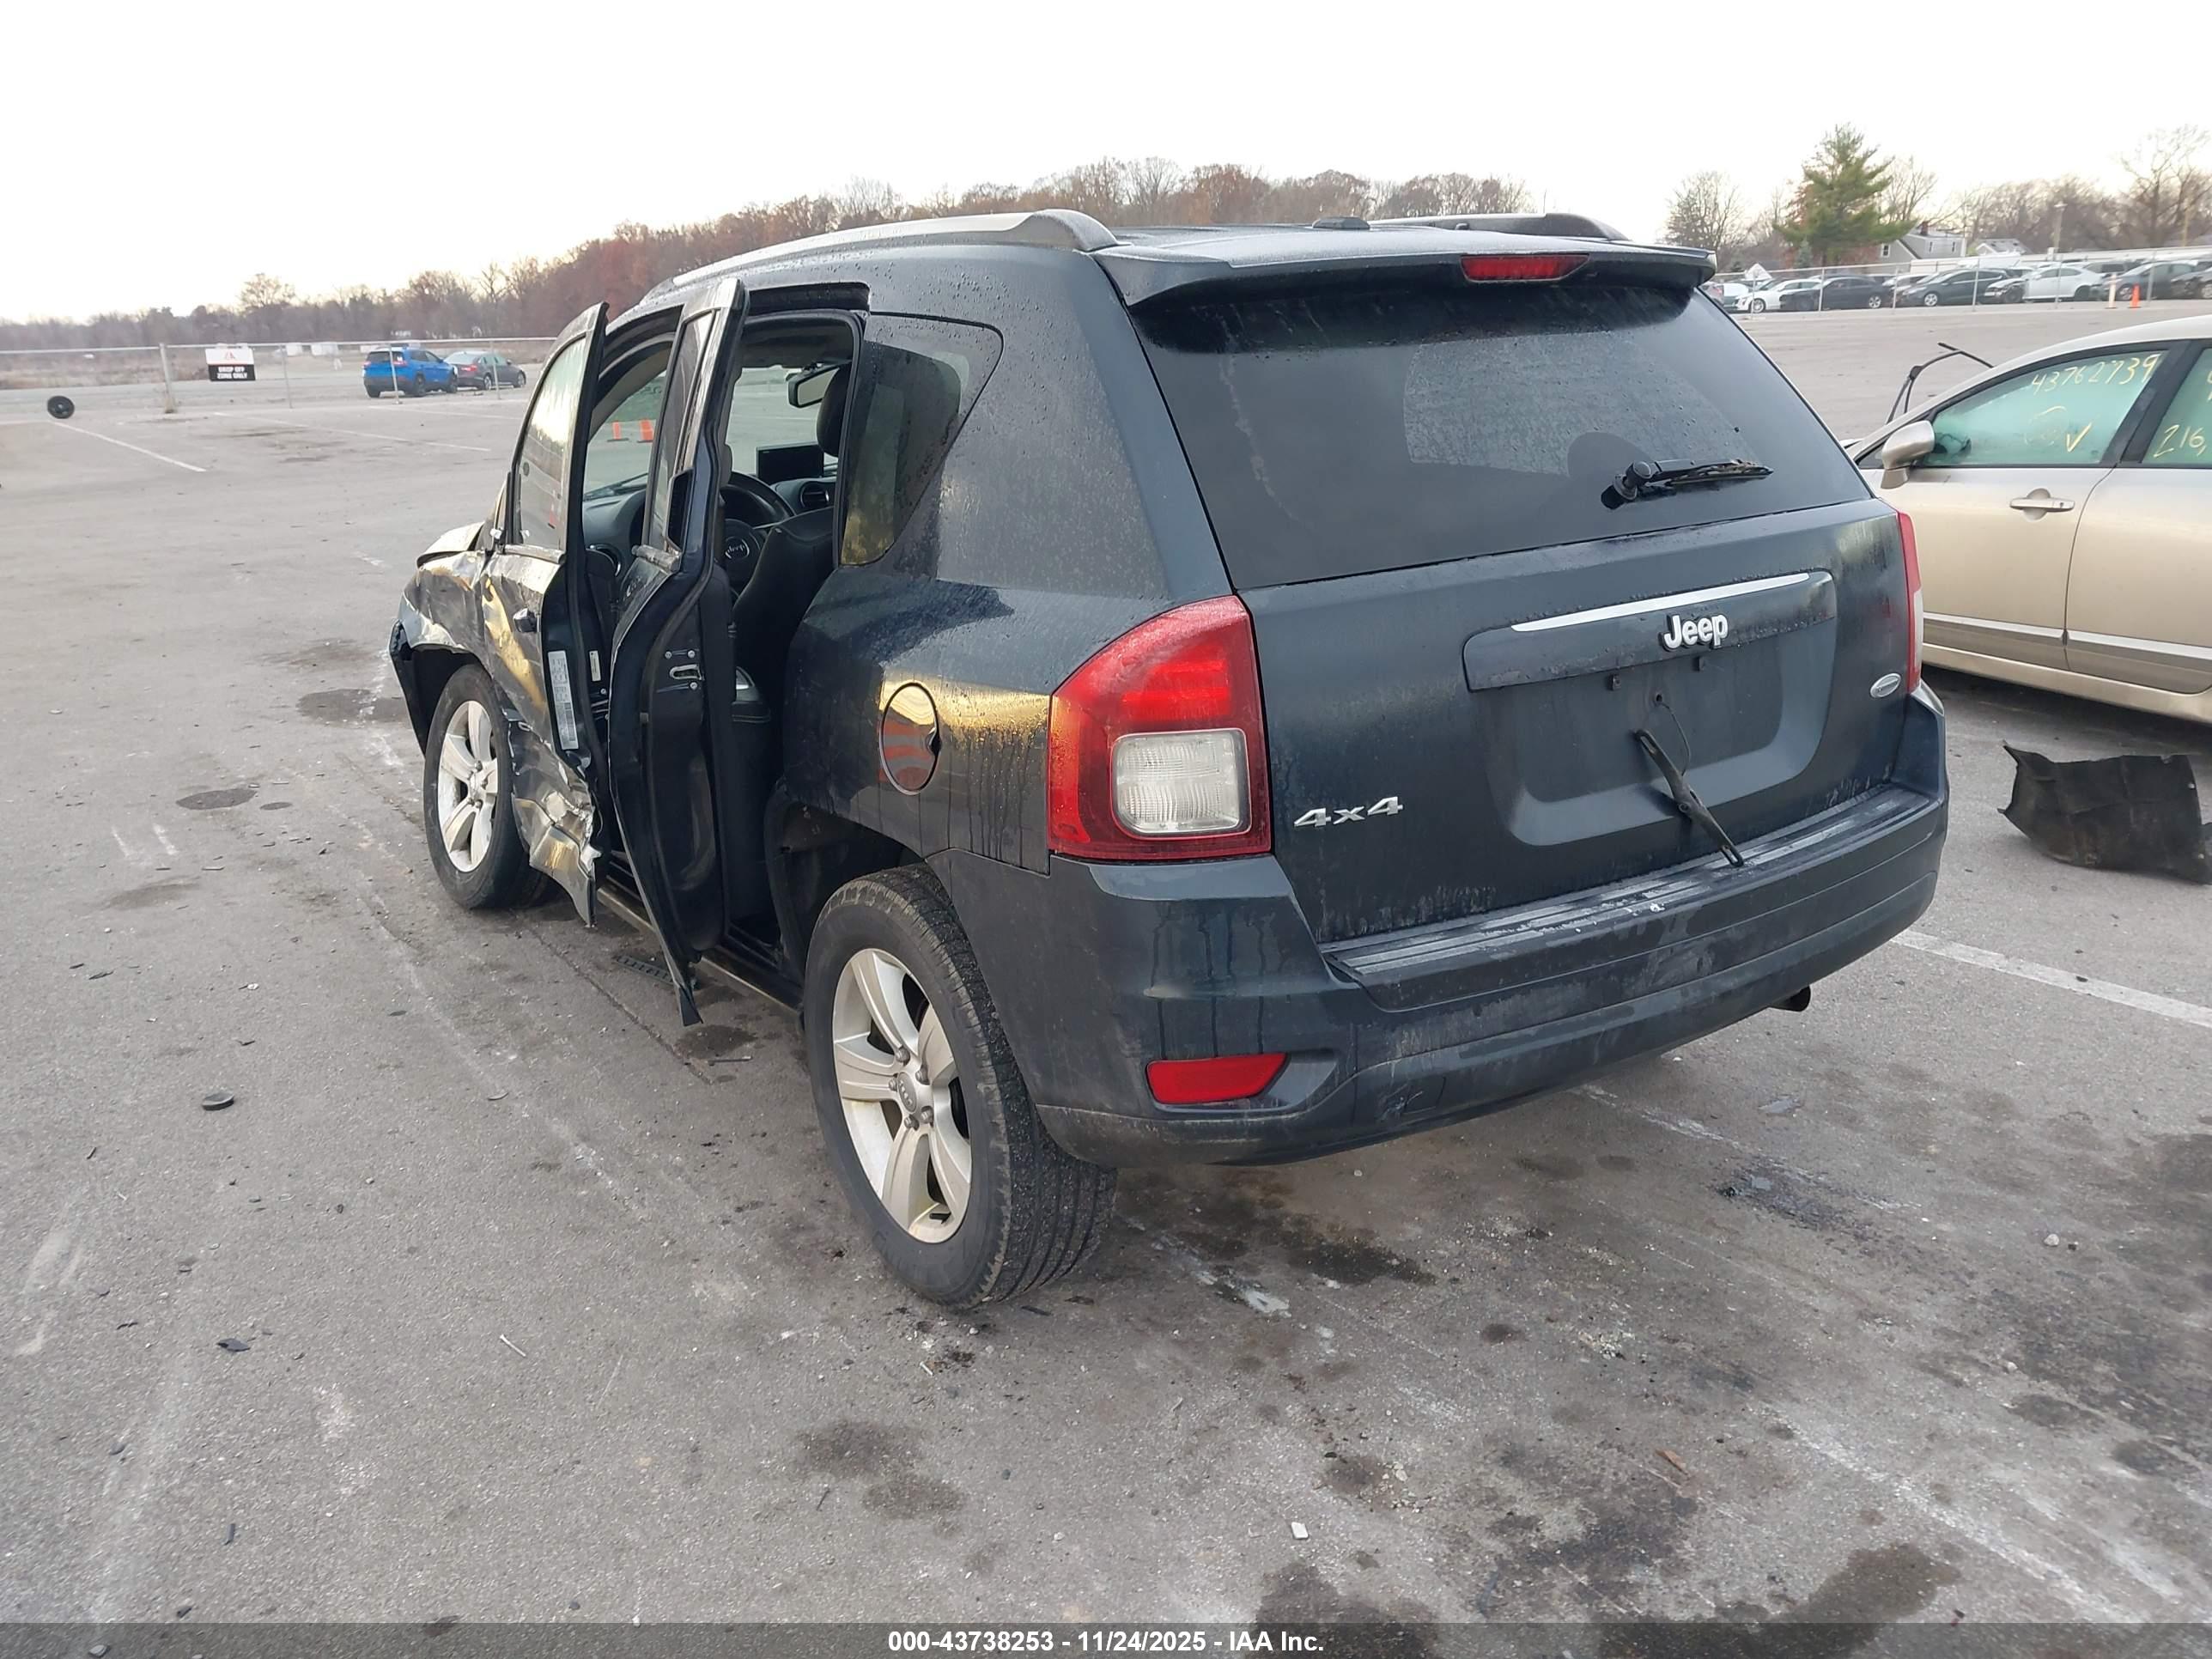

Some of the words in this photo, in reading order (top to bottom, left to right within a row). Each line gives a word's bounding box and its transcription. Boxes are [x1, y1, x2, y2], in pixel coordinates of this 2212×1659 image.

[2032, 353, 2161, 394] 43762739
[1663, 614, 1729, 649] Jeep
[1293, 795, 1404, 828] 4x4
